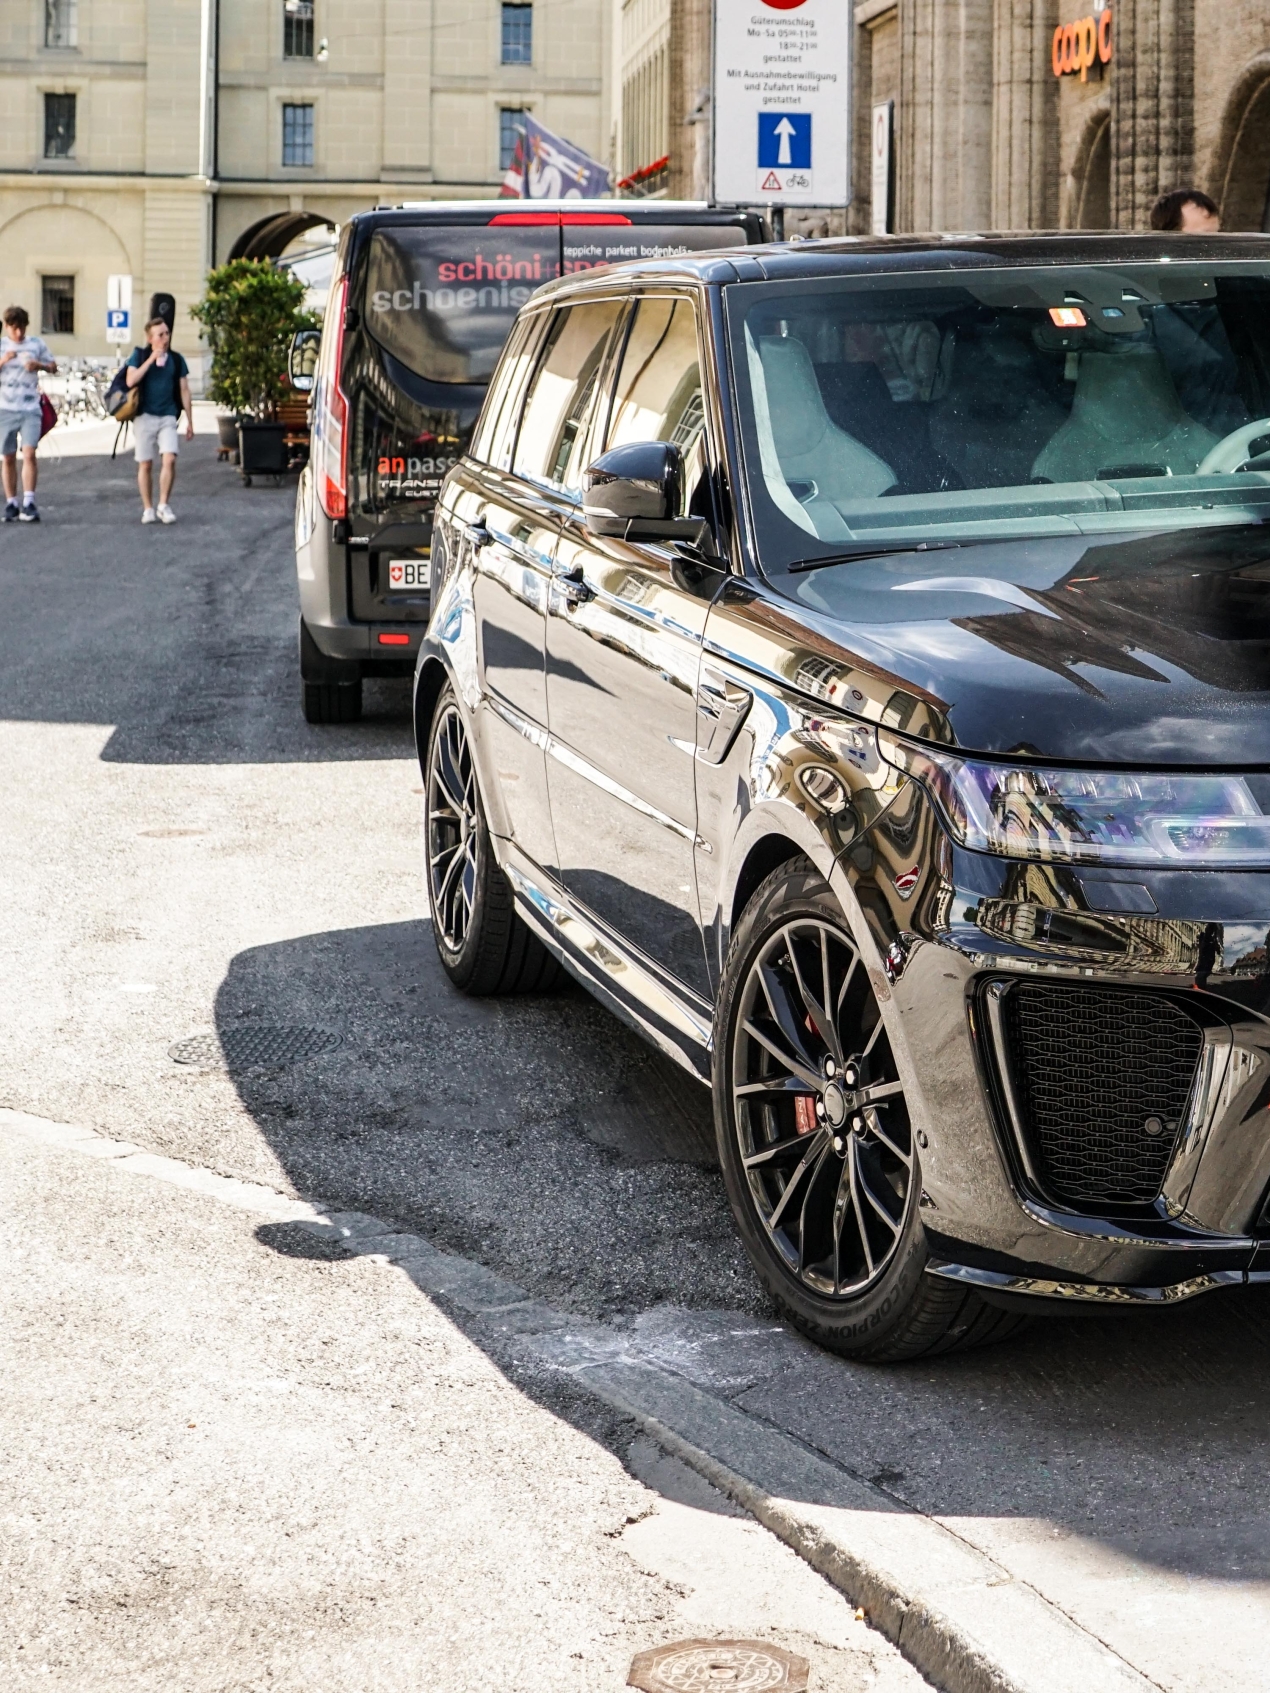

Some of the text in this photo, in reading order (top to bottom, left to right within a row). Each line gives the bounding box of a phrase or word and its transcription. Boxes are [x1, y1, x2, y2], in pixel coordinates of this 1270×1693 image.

[750, 15, 815, 28] Güterumschlag
[1052, 15, 1097, 82] coop
[763, 54, 802, 64] gestattet
[727, 69, 837, 82] Mit Ausnahmebewilligung
[744, 82, 819, 92] und Zufahrt Hotel
[763, 95, 801, 105] gestattet
[564, 245, 602, 258] teppiche
[605, 245, 637, 258] parkett
[372, 280, 536, 312] schoenis
[112, 312, 125, 328] P
[405, 564, 428, 584] BE
[825, 1273, 909, 1340] SCORPION
